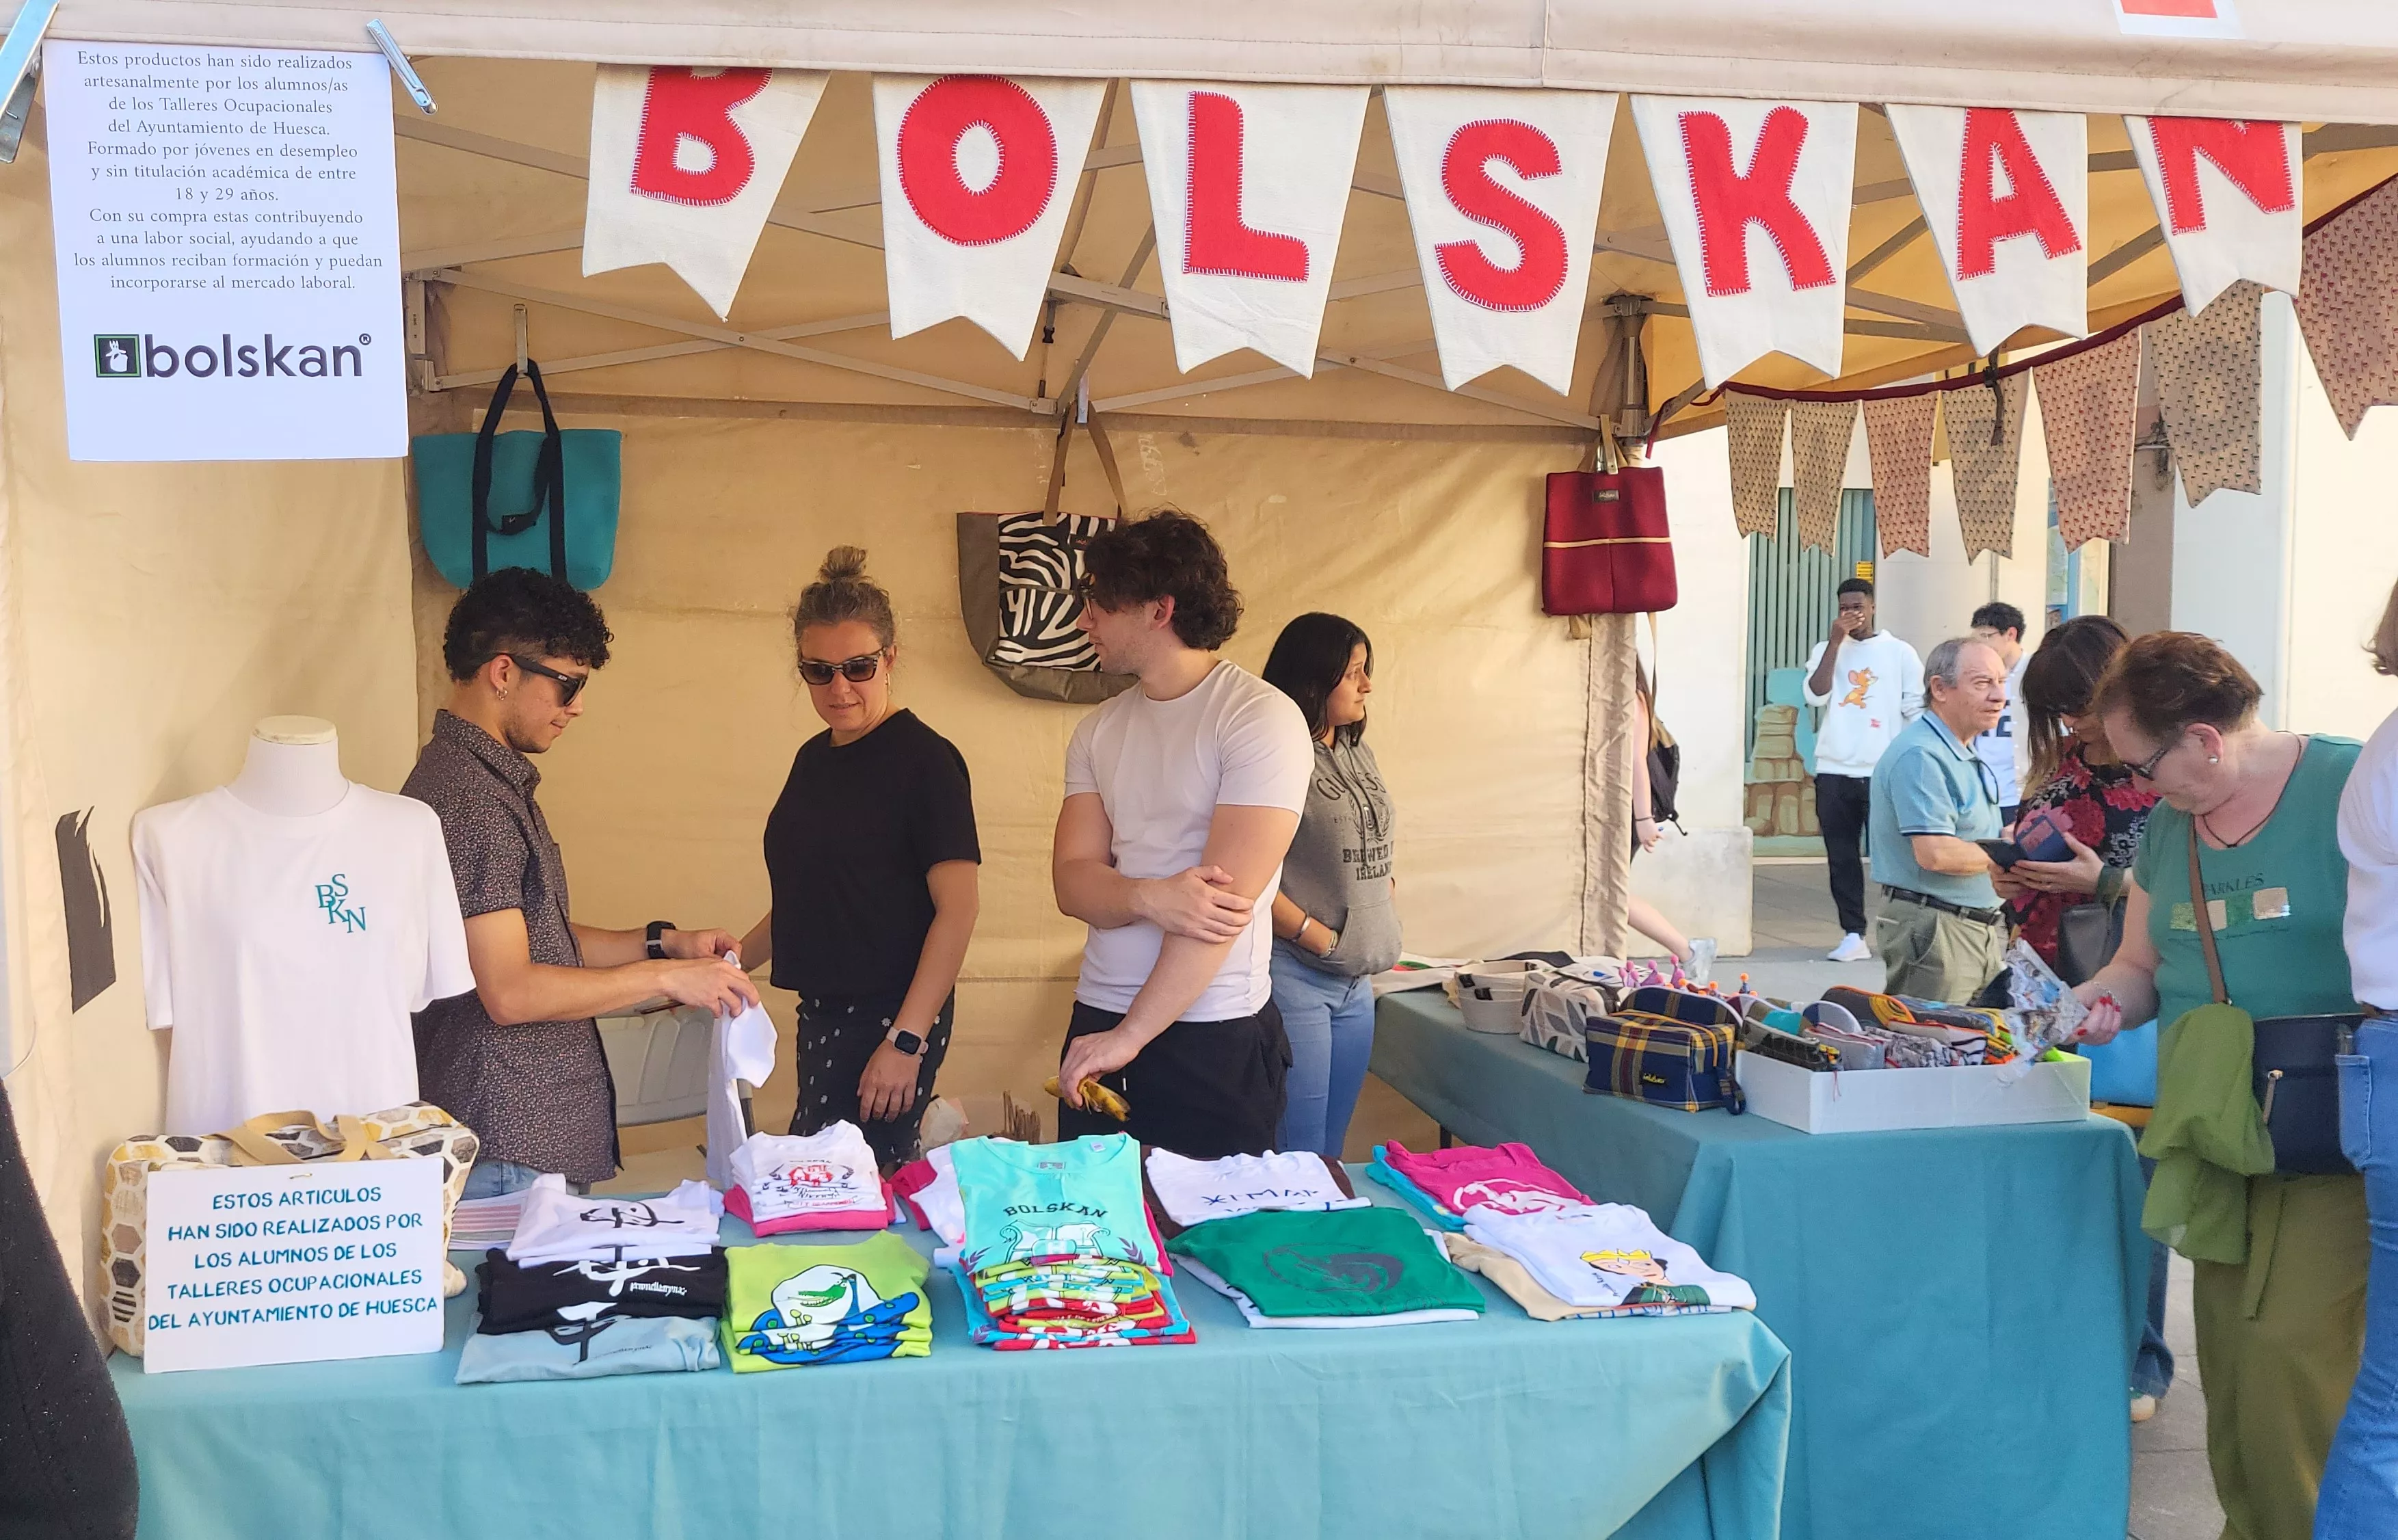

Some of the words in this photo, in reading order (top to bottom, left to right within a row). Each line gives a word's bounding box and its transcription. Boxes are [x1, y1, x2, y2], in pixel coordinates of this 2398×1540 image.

[77, 51, 118, 65] Estos
[124, 52, 201, 69] productos
[206, 53, 235, 67] han
[241, 54, 271, 68] sido
[277, 55, 352, 70] realizados
[84, 74, 200, 89] artesanalmente
[205, 80, 232, 93] por
[237, 76, 258, 90] los
[264, 76, 348, 94] alumnos/as
[109, 96, 126, 110] de
[131, 96, 154, 111] los
[159, 97, 218, 111] Talleres
[224, 98, 332, 116] Ocupacionales
[108, 118, 131, 133] del
[136, 120, 243, 137] Ayuntamiento
[250, 120, 267, 135] de
[273, 121, 330, 135] Huesca.
[87, 141, 157, 155] Formado
[162, 146, 189, 159] por
[194, 142, 250, 159] jóvenes
[256, 147, 274, 157] en
[280, 143, 358, 161] desempleo
[90, 168, 101, 181] y
[106, 164, 129, 177] sin
[135, 163, 207, 178] titulación
[212, 165, 290, 179] académica
[295, 165, 312, 179] de
[318, 168, 356, 180] entre
[175, 187, 194, 200] 18
[200, 191, 209, 204] y
[215, 187, 234, 200] 29
[241, 187, 278, 201] años.
[90, 208, 122, 222] Con
[128, 213, 145, 222] su
[150, 213, 208, 226] compra
[213, 211, 249, 223] estas
[254, 209, 363, 227] contribuyendo
[96, 235, 105, 244] a
[110, 235, 139, 244] una
[144, 230, 184, 244] labor
[189, 230, 235, 246] social,
[241, 231, 313, 249] ayudando
[319, 236, 327, 245] a
[332, 236, 358, 249] que
[74, 252, 96, 266] los
[101, 252, 165, 267] alumnos
[171, 252, 227, 267] reciban
[232, 252, 310, 267] formación
[315, 258, 323, 271] y
[329, 253, 383, 271] puedan
[111, 275, 207, 293] incorporarse
[213, 275, 225, 289] al
[231, 275, 295, 289] mercado
[301, 275, 356, 289] laboral.
[213, 1192, 274, 1210] ESTOS
[278, 1186, 382, 1207] ARTICULOS
[1002, 1201, 1109, 1219] BOLSKAN
[168, 1224, 210, 1242] HAN
[215, 1221, 258, 1239] SIDO
[263, 1214, 381, 1236] REALIZADOS
[386, 1212, 423, 1229] POR
[194, 1251, 232, 1269] LOS
[238, 1246, 329, 1266] ALUMNOS
[334, 1245, 356, 1261] DE
[360, 1242, 397, 1260] LOS
[167, 1279, 263, 1300] TALLERES
[267, 1269, 423, 1294] OCUPACIONALES
[148, 1313, 183, 1331] DEL
[187, 1303, 334, 1328] AYUNTAMIENTO
[338, 1301, 361, 1318] DE
[365, 1297, 438, 1316] HUESCA
